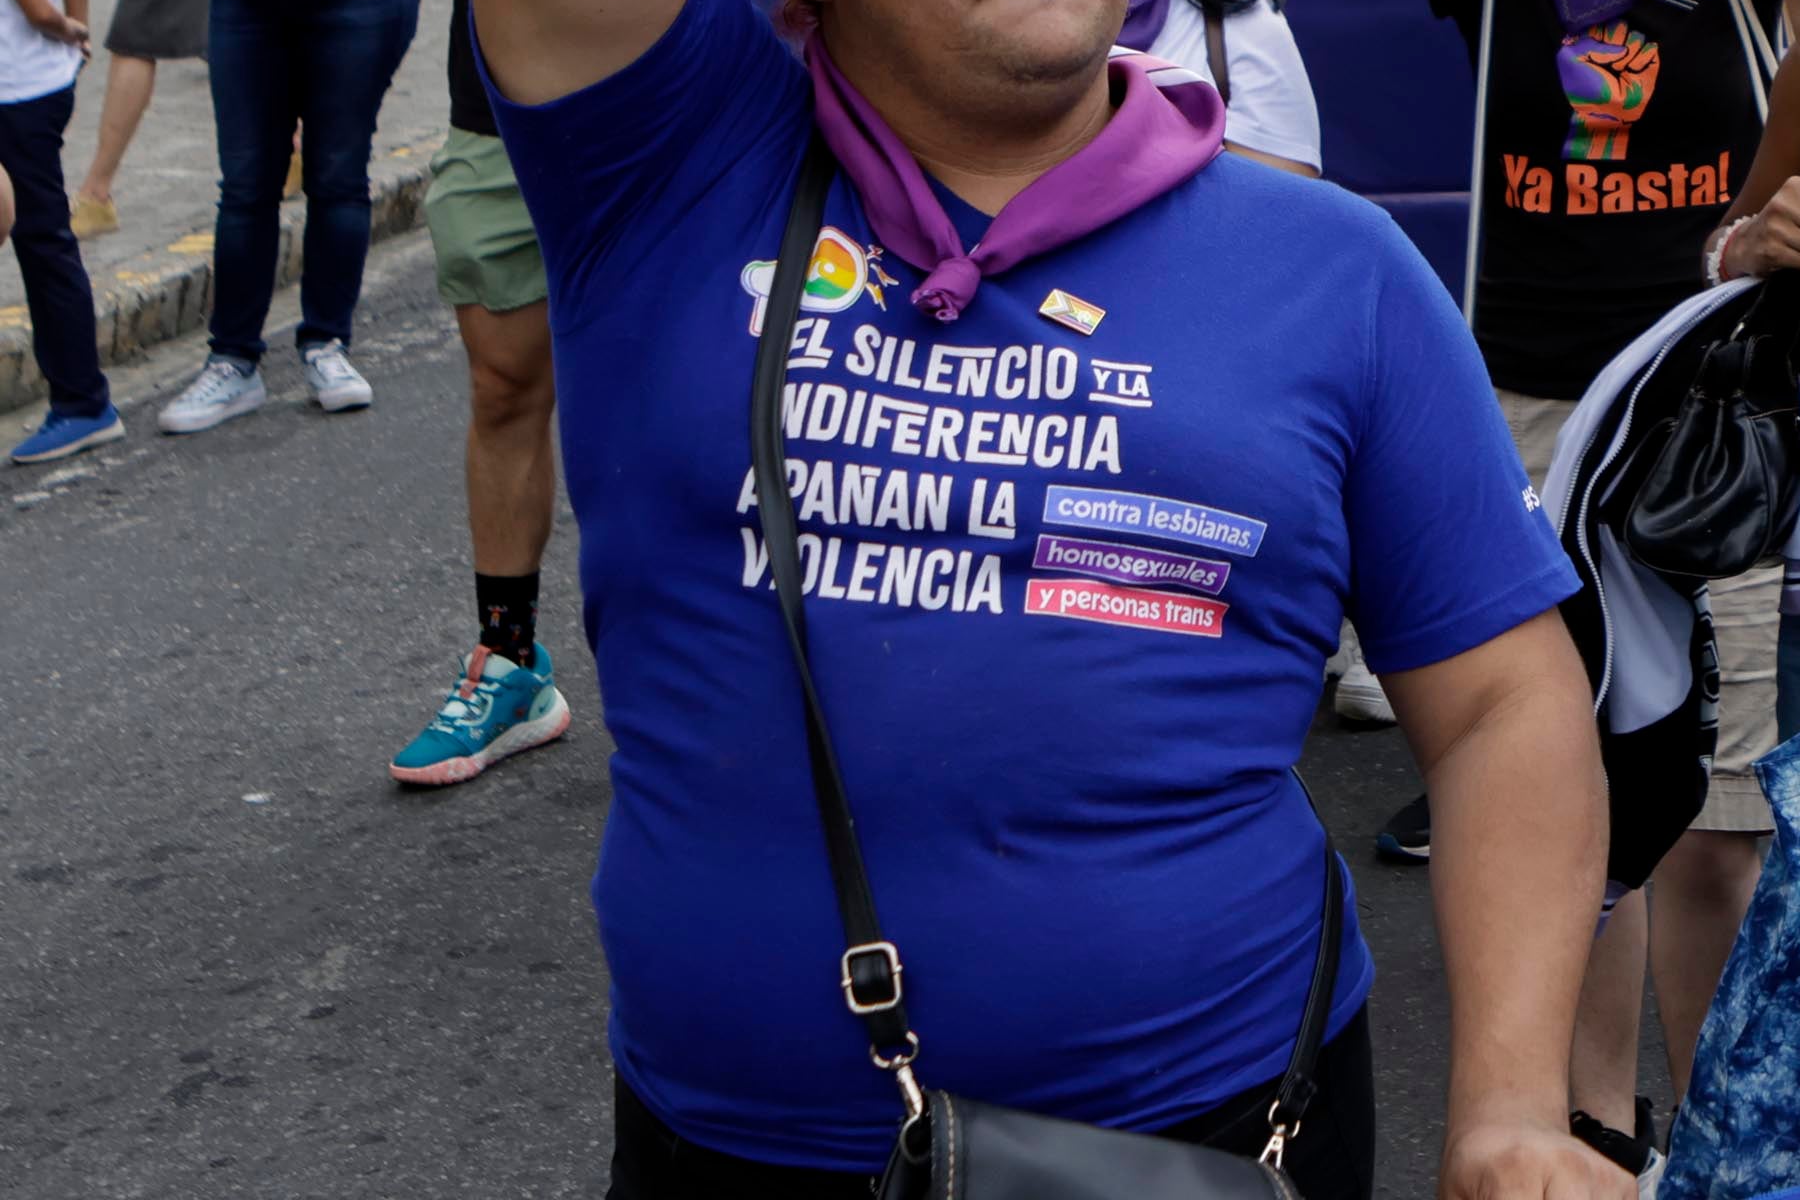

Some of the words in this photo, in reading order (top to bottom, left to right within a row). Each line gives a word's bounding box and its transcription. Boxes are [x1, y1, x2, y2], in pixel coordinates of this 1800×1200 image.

[1503, 153, 1553, 214] Ya
[1566, 151, 1731, 216] Basta!
[845, 323, 1079, 401] SILENCIO
[1118, 374, 1151, 398] LA
[779, 381, 1122, 474] NDIFERENCIA
[967, 477, 1017, 539] LA
[1057, 496, 1142, 526] contra
[739, 527, 1004, 615] VOLENCIA
[1047, 539, 1218, 587] homosexuales
[1038, 586, 1056, 610] y
[1060, 587, 1161, 621] personas
[1164, 600, 1215, 629] trans
